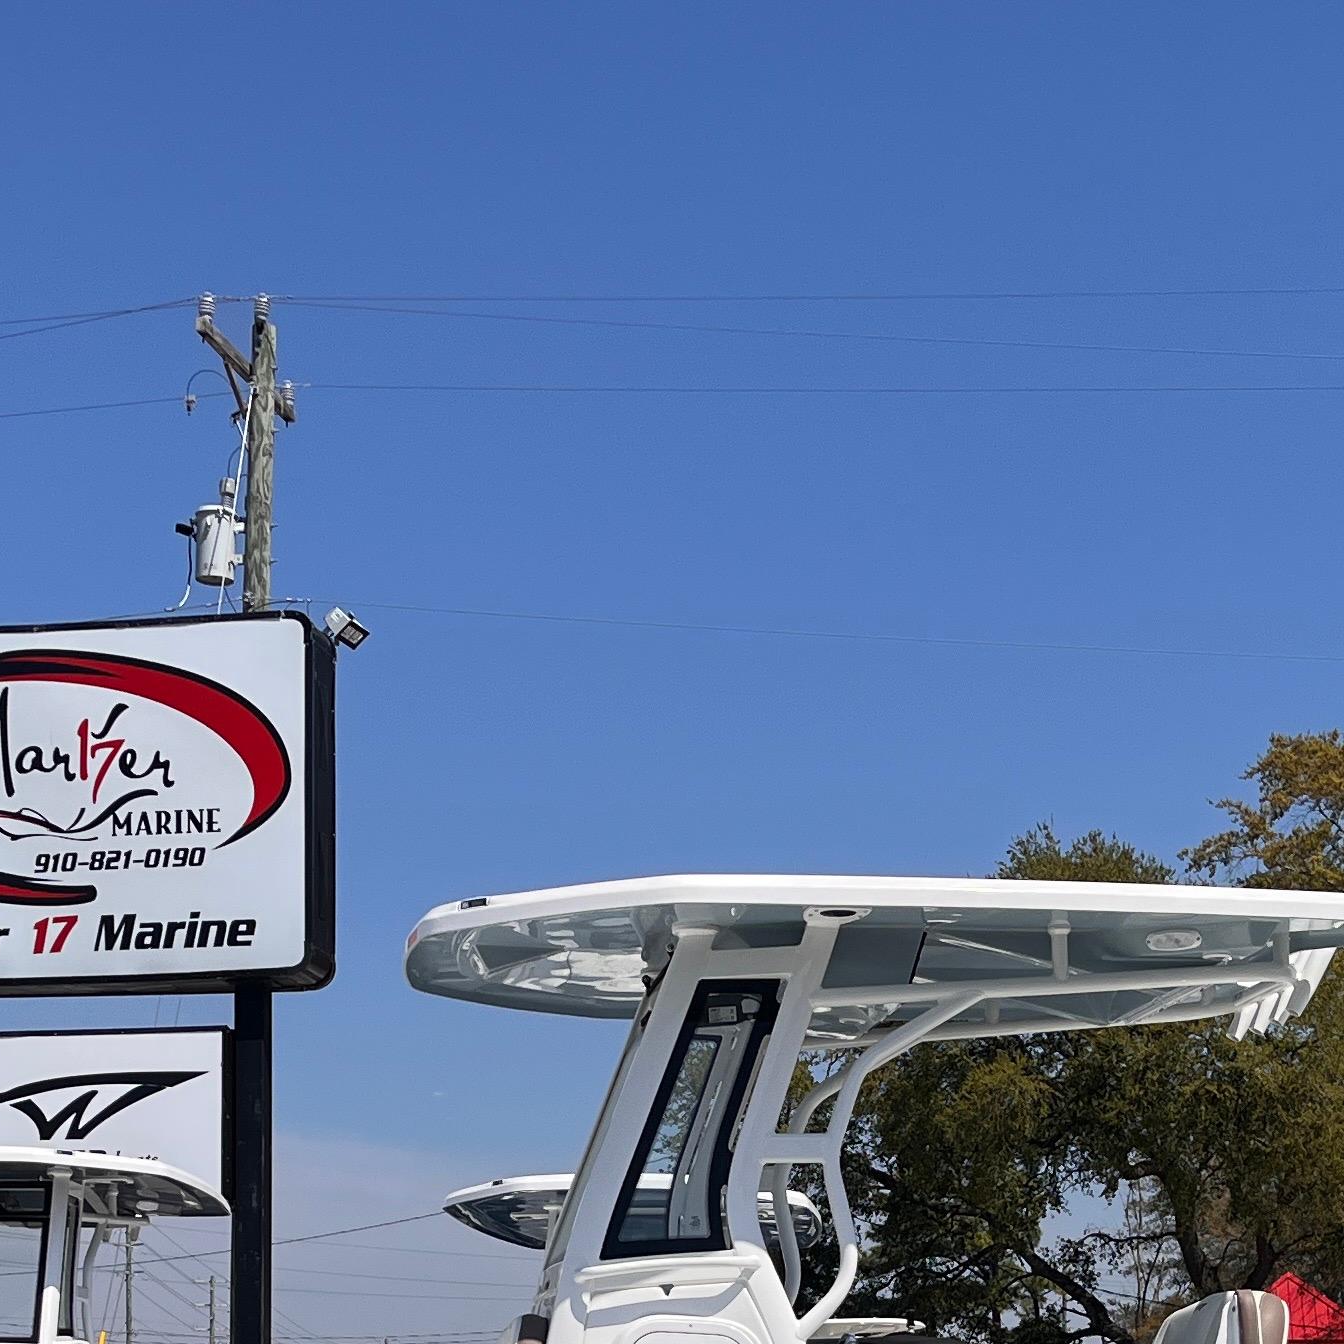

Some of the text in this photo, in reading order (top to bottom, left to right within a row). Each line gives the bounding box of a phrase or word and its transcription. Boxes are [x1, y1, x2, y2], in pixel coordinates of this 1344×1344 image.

[111, 807, 222, 838] MARINE
[33, 846, 206, 874] 910-821-0190
[31, 915, 78, 955] 17
[93, 911, 257, 952] Marine
